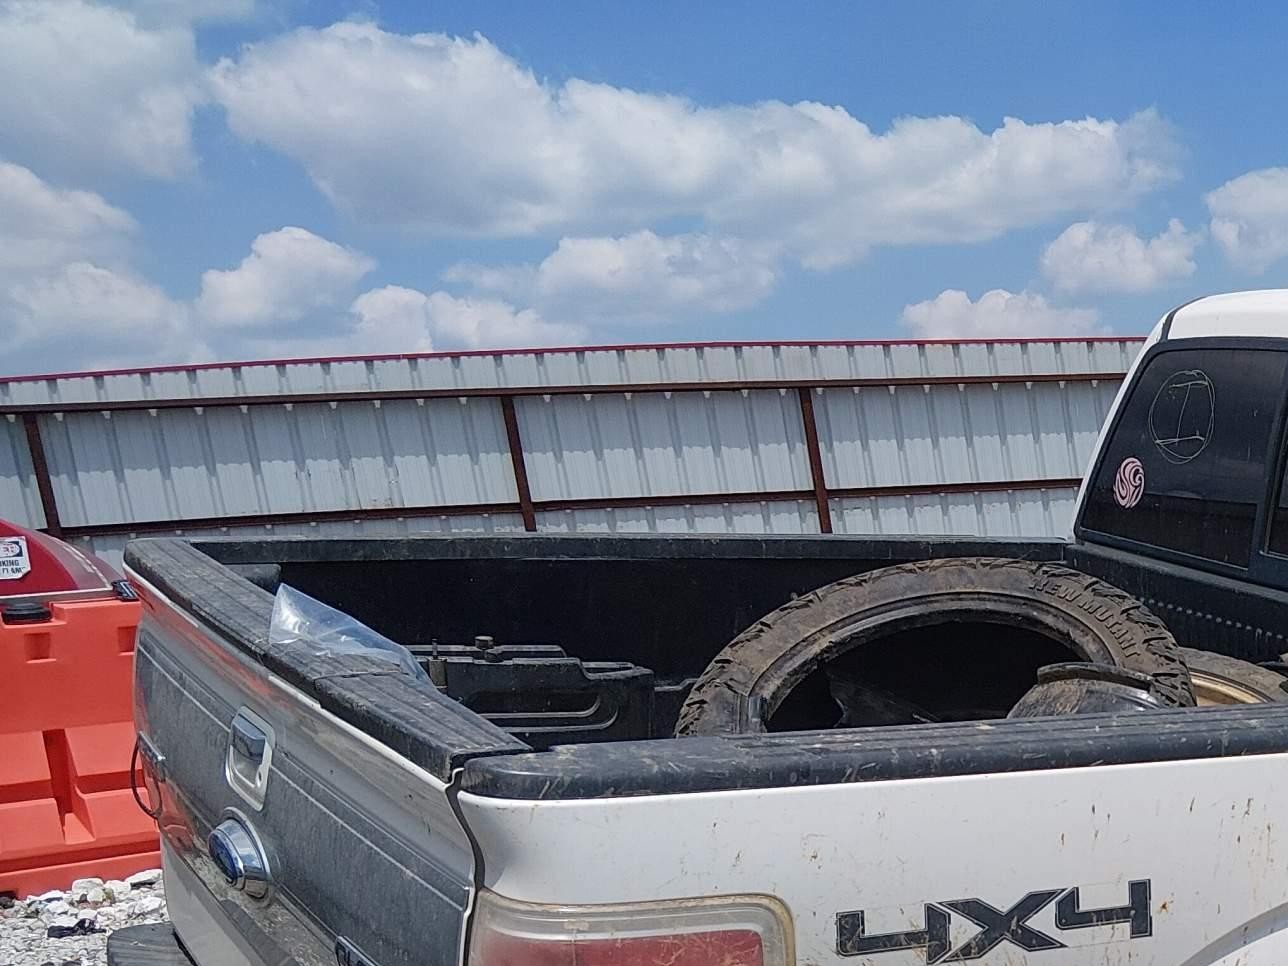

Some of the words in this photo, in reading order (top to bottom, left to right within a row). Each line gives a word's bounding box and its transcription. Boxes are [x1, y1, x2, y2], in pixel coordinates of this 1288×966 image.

[1028, 576, 1083, 602] NEW
[1077, 601, 1141, 658] MUTANT
[836, 879, 1153, 965] 4X4
